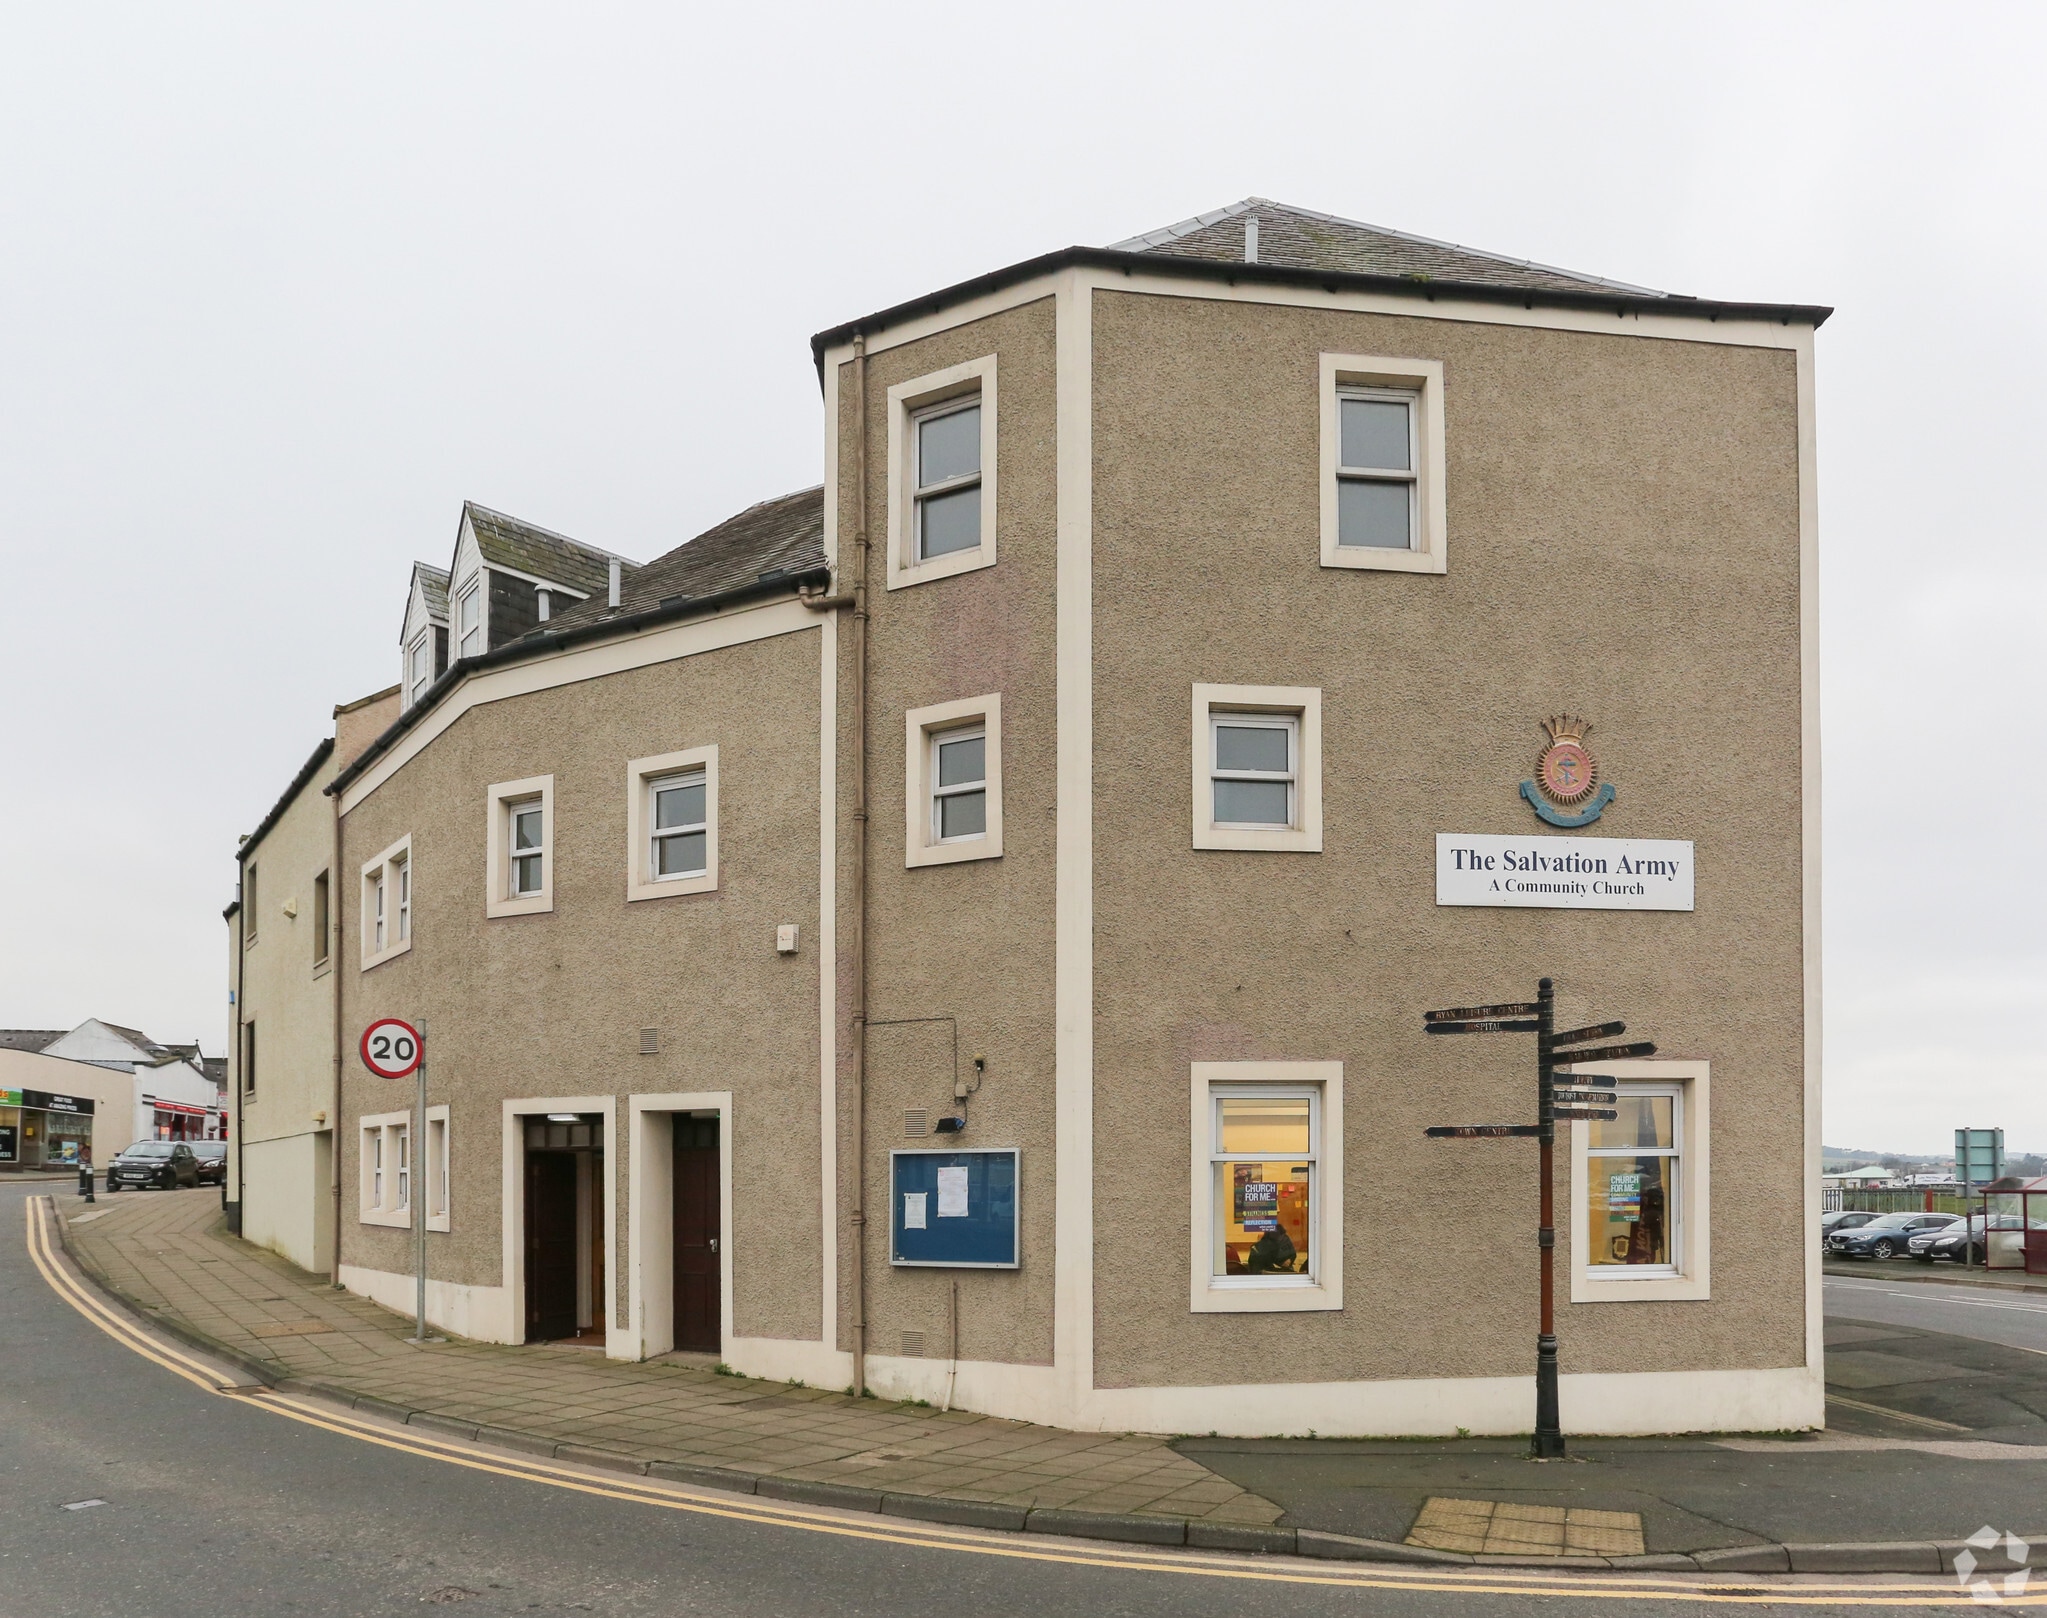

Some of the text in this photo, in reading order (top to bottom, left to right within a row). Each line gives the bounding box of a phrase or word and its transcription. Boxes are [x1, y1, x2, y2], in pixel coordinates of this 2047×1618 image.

[1451, 849, 1680, 882] The Salvation Army
[1489, 878, 1645, 898] A Community Church
[1435, 1010, 1457, 1020] RYAN
[1465, 1022, 1503, 1032] HOSPITAL
[372, 1035, 415, 1061] 20
[1611, 1175, 1639, 1184] CHURCH
[1245, 1184, 1276, 1193] CHURCH
[1611, 1184, 1624, 1192] FOR
[1245, 1192, 1259, 1201] FOR
